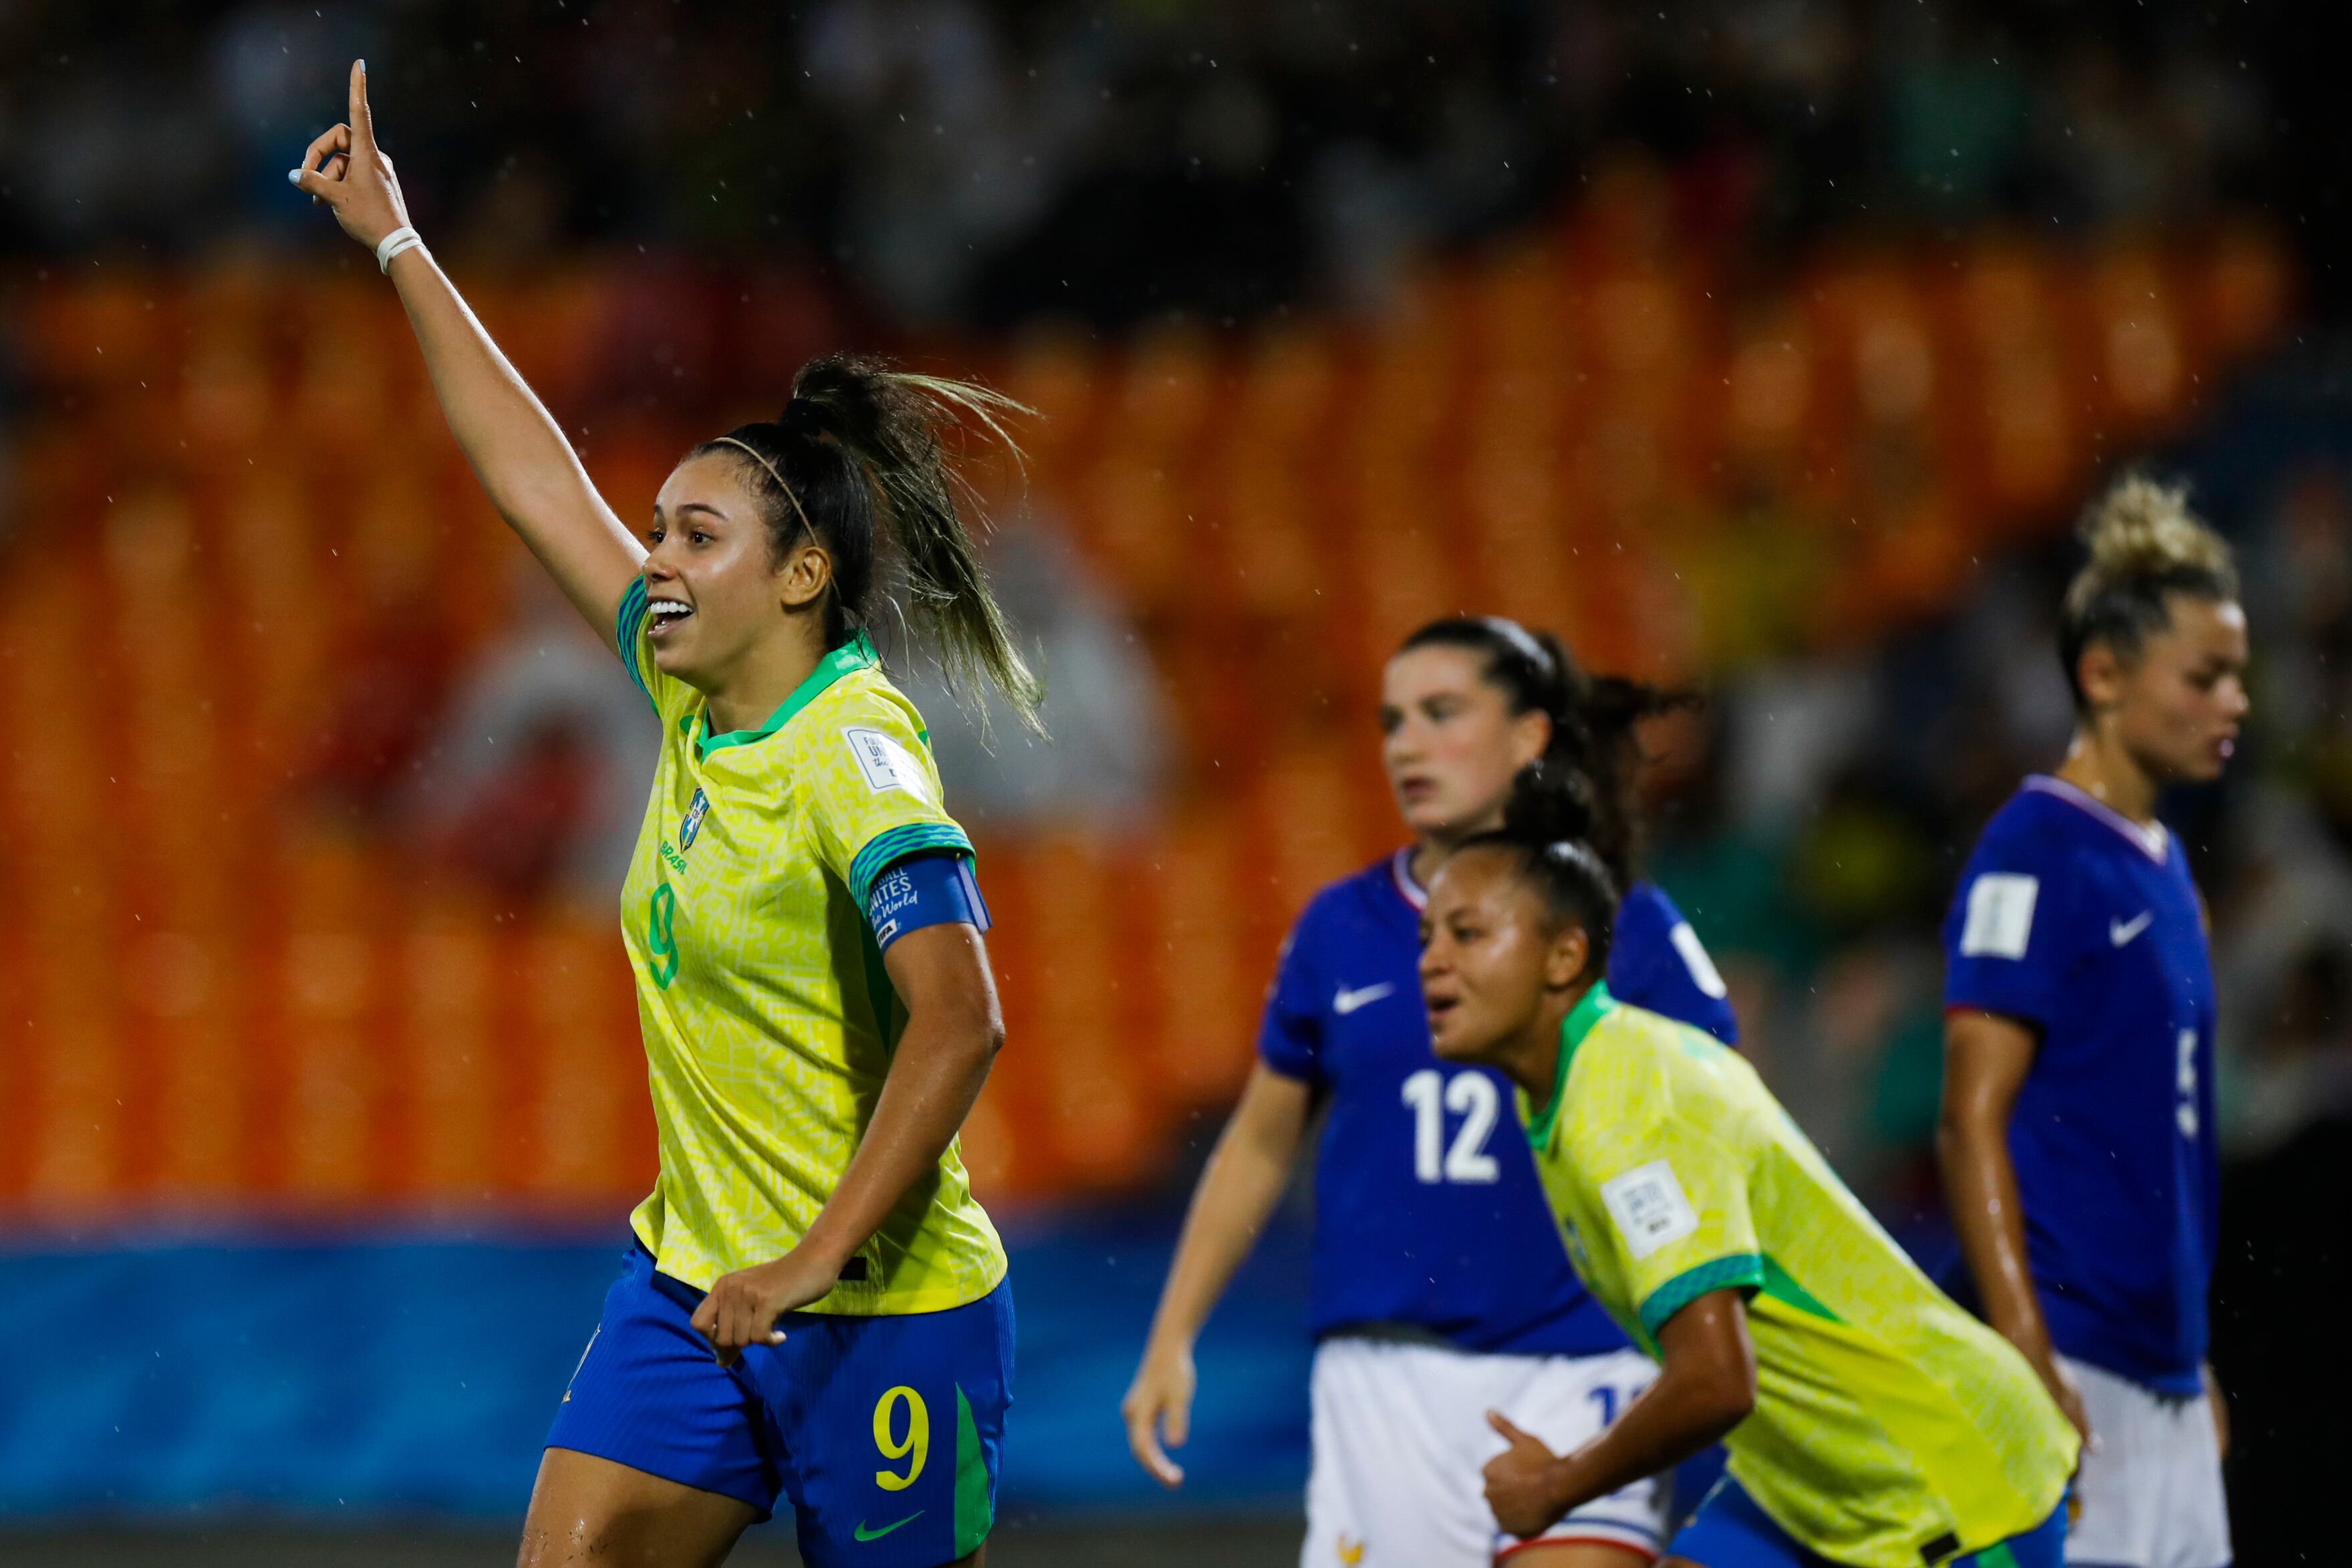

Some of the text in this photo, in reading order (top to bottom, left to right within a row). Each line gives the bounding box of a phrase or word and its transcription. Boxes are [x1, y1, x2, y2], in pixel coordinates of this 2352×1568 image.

[650, 882, 678, 991] 9
[881, 890, 918, 918] World
[1403, 1071, 1499, 1183] 12
[873, 1386, 930, 1491] 9
